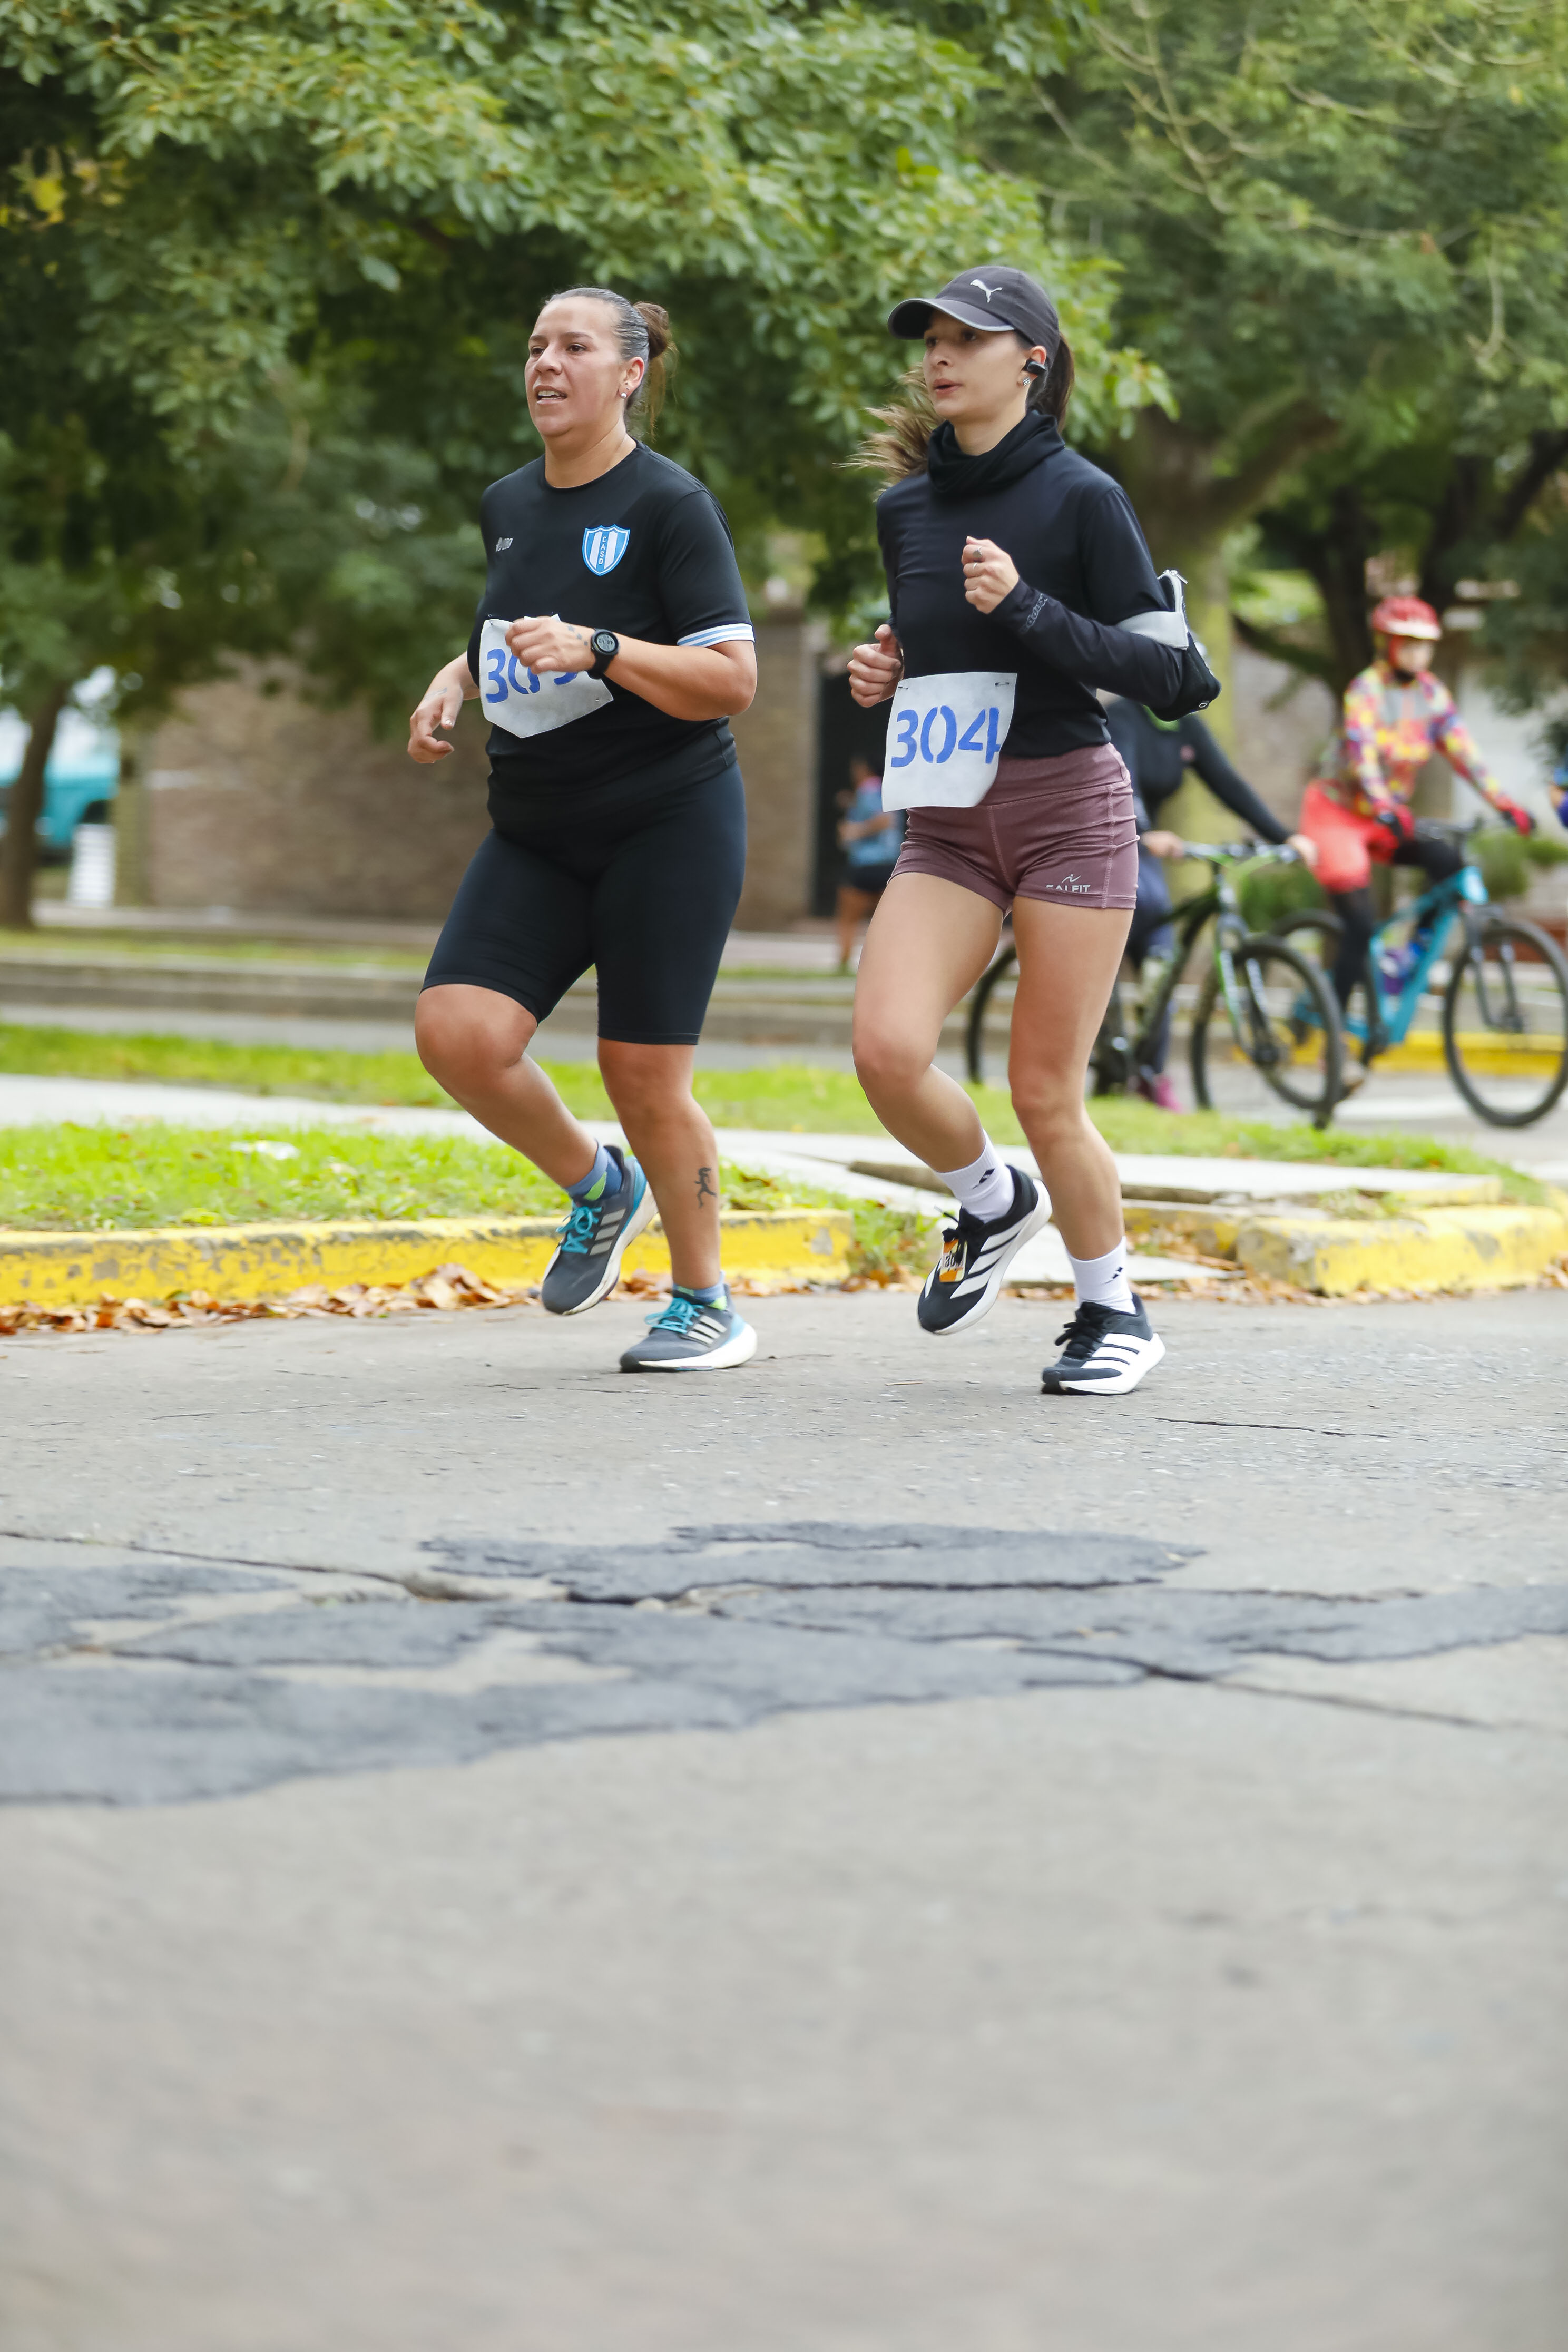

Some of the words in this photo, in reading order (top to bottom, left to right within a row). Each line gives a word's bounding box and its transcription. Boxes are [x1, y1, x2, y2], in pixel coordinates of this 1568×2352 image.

[599, 536, 607, 565] CASD
[485, 648, 579, 704] 30
[891, 705, 1001, 768] 304
